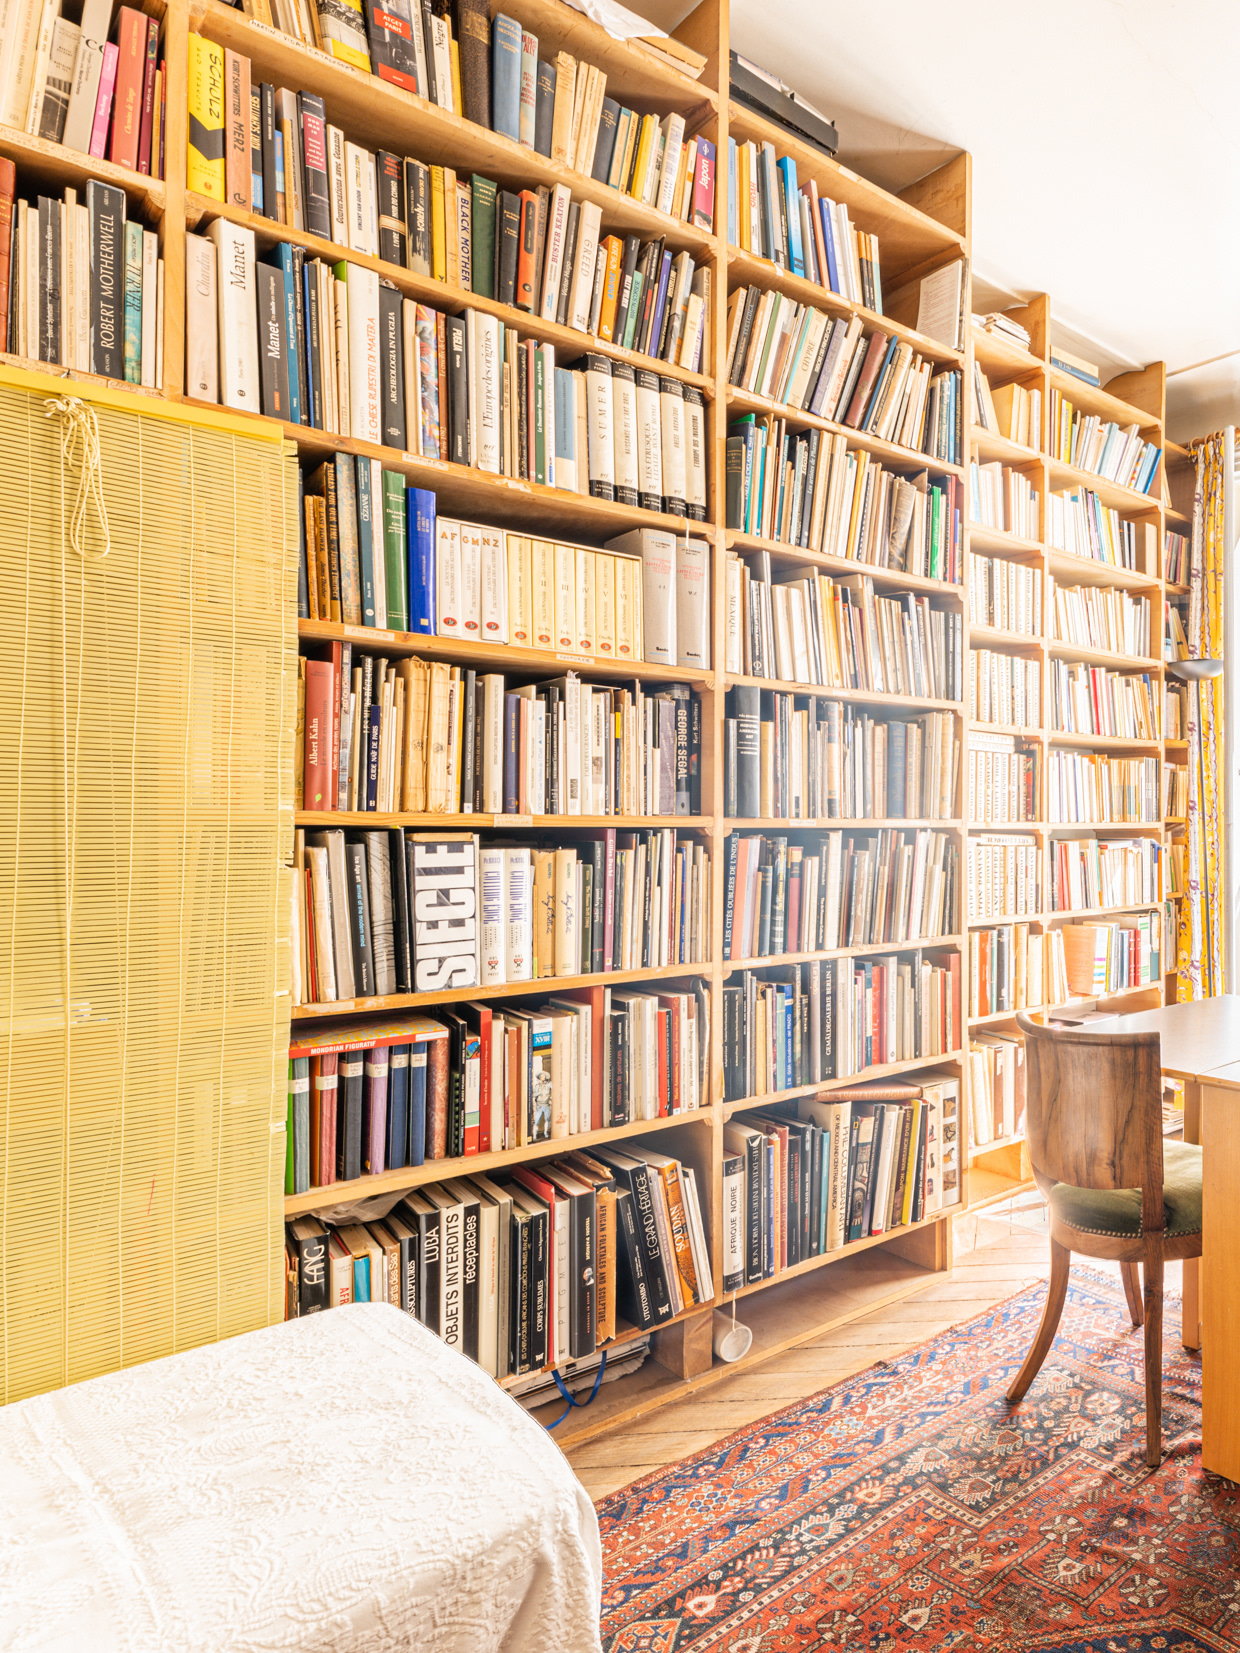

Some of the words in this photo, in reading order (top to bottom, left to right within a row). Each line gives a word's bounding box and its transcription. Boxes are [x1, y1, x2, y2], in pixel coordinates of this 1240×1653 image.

[383, 15, 403, 27] ATGET
[385, 22, 402, 34] PARIS
[435, 21, 445, 50] Nègre
[523, 43, 535, 57] ALLY
[232, 59, 240, 77] KURT
[209, 53, 222, 120] SCHULZ
[233, 77, 241, 117] SCHWITTERS
[233, 120, 245, 153] MERZ
[307, 117, 320, 126] ODD
[308, 123, 321, 131] MAN
[334, 161, 342, 177] avec
[699, 158, 709, 190] Japon
[335, 178, 345, 226] Conversations
[460, 197, 470, 233] BLACK
[556, 195, 565, 230] KEATON
[414, 204, 425, 232] AFRICA
[100, 214, 114, 299] MOTHERWELL
[461, 237, 470, 282] MOTHER
[552, 232, 561, 264] BUSTER
[582, 239, 593, 277] GREED
[198, 251, 211, 297] Chardin
[230, 239, 246, 291] Manet
[564, 260, 573, 275] Hugo
[126, 263, 141, 312] TURNER
[561, 276, 570, 296] Victor
[621, 289, 631, 309] WILDER
[633, 280, 641, 301] SCORSESE
[100, 300, 115, 350] ROBERT
[267, 320, 280, 359] Manet
[367, 318, 376, 353] MATERA
[453, 328, 463, 352] PUGLIA
[367, 354, 376, 363] DI
[481, 330, 494, 368] origines
[802, 340, 816, 372] CHYPRE
[367, 366, 377, 401] RUPESTRI
[482, 369, 492, 385] des
[369, 403, 378, 428] CHIESE
[482, 386, 496, 429] L'Europe
[598, 385, 607, 440] SUMER
[369, 430, 378, 440] LE
[361, 494, 369, 522] CÉZANNE
[441, 531, 448, 539] A
[450, 532, 457, 540] F
[462, 536, 469, 544] G
[471, 538, 479, 546] M
[482, 537, 491, 546] N
[492, 539, 500, 547] Z
[331, 571, 339, 598] Thurber
[728, 595, 737, 637] MEXIQUE
[310, 718, 318, 740] Kahn
[677, 709, 687, 748] GEORGE
[309, 742, 318, 766] Albert
[678, 751, 688, 780] SEGAL
[483, 871, 501, 902] CUTTING
[730, 867, 736, 879] DE
[727, 880, 735, 910] OUBLIÉES
[415, 845, 477, 992] SIECLE
[483, 904, 501, 924] EDGE
[509, 903, 524, 923] EDGE
[310, 1045, 344, 1055] MONDRIAN
[345, 1041, 376, 1051] FIGURATIF
[635, 1173, 653, 1215] HÉRITAGE
[599, 1205, 607, 1235] AFRICAN
[643, 1215, 659, 1247] GRAND
[670, 1206, 686, 1252] SOUDAN
[424, 1225, 440, 1264] LUBA
[446, 1212, 459, 1287] INTERDITS
[465, 1215, 477, 1285] réceptacles
[599, 1237, 607, 1268] FOLKTALES
[649, 1247, 660, 1260] LE
[303, 1245, 325, 1285] FANG
[388, 1252, 398, 1271] Sao
[390, 1271, 398, 1285] des
[599, 1271, 607, 1284] AND
[445, 1289, 459, 1346] OBJETS
[598, 1287, 606, 1324] SCULPTURE
[639, 1282, 650, 1322] UTOTOMBO
